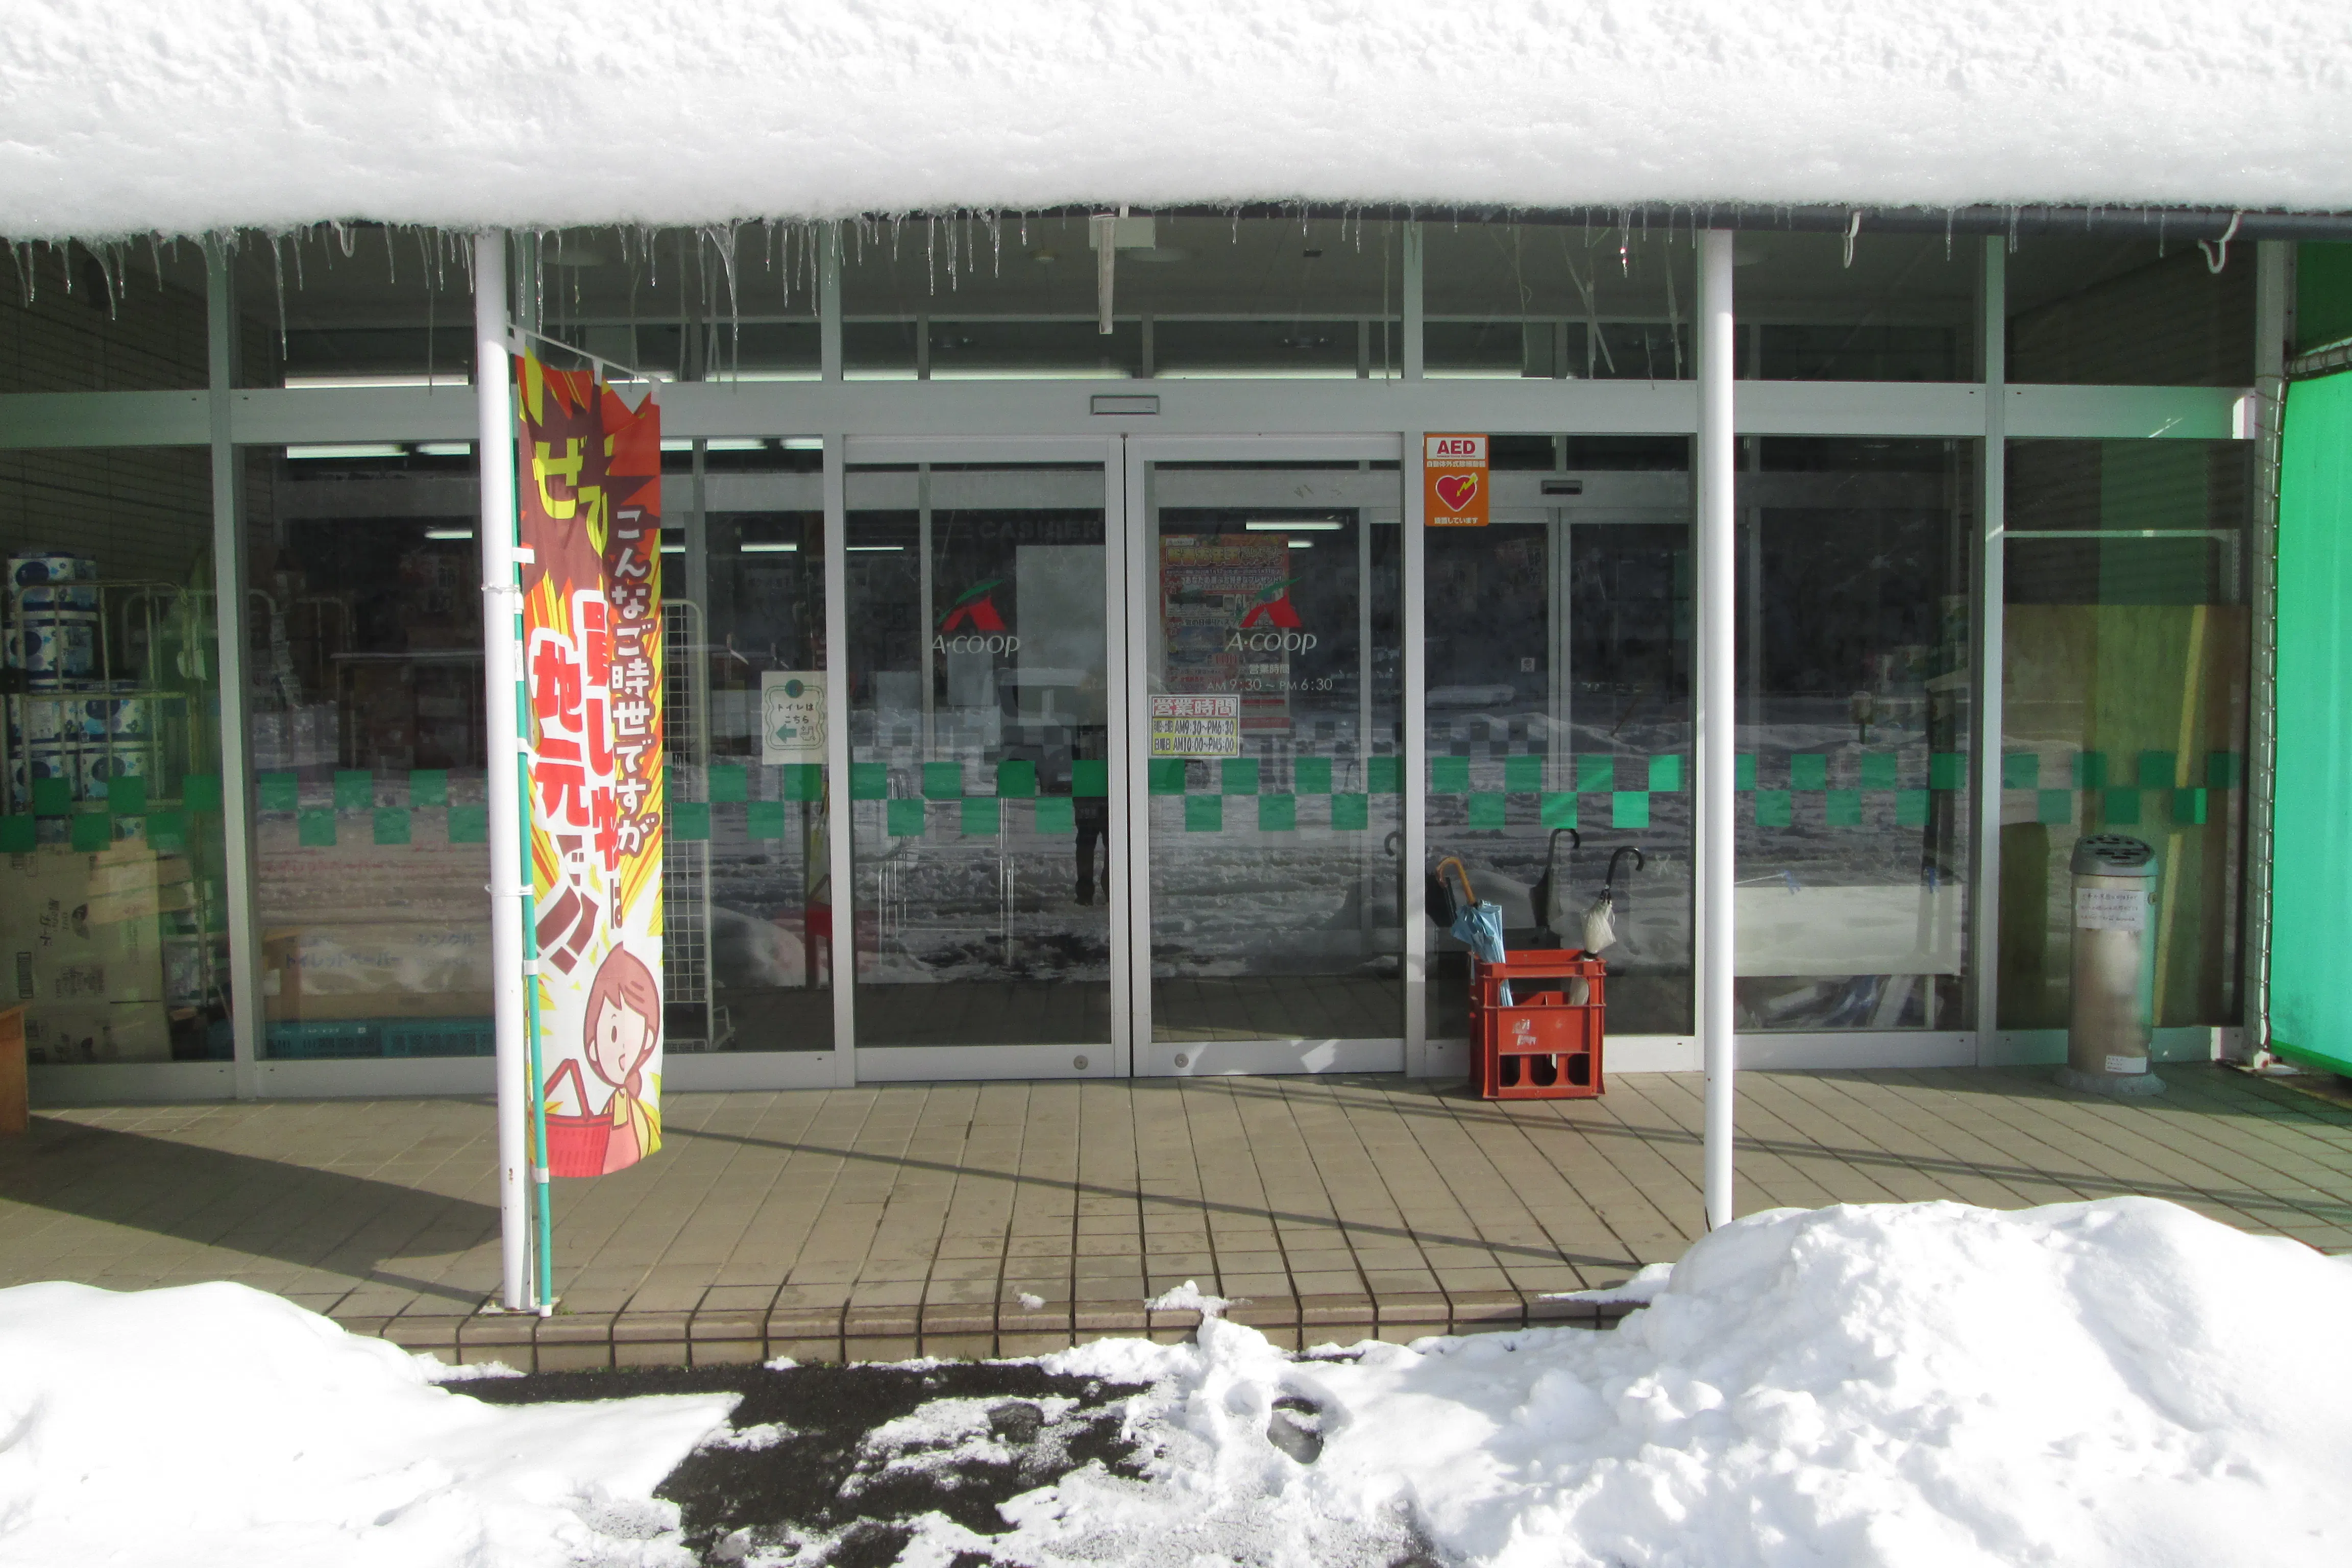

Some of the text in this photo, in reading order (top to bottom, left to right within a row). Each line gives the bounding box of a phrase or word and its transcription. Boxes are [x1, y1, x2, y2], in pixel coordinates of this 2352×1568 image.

[1437, 440, 1476, 454] AED
[1248, 664, 1290, 675] 営業時間
[611, 509, 655, 853] こんなご時世ですが
[1207, 682, 1226, 691] AM
[1229, 678, 1262, 691] 9:30
[1279, 682, 1297, 691] PM
[1301, 678, 1333, 691] 6:30
[777, 703, 815, 712] トイレは
[1153, 699, 1236, 716] 営業時間
[785, 715, 810, 724] こちら
[1155, 738, 1171, 751] 日曜日
